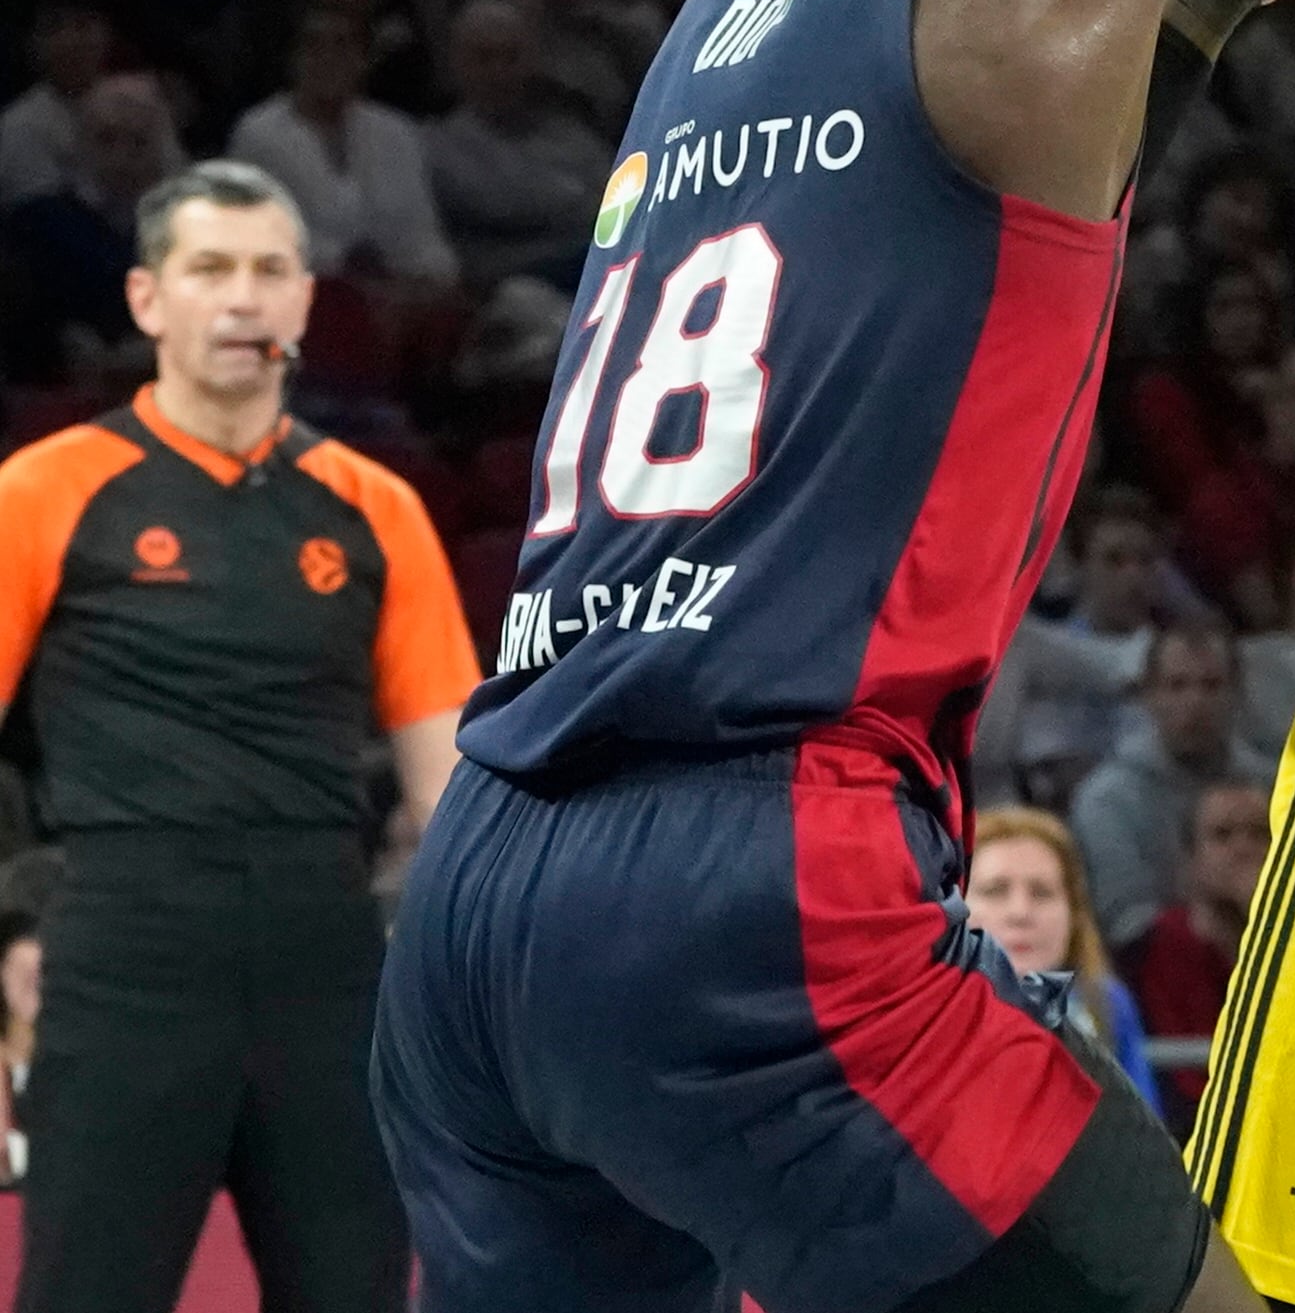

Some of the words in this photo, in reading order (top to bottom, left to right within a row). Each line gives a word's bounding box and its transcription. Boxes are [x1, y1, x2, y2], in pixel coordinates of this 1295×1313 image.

[647, 109, 865, 213] AMUTIO
[665, 119, 695, 145] GRUPO
[528, 222, 783, 539] 18
